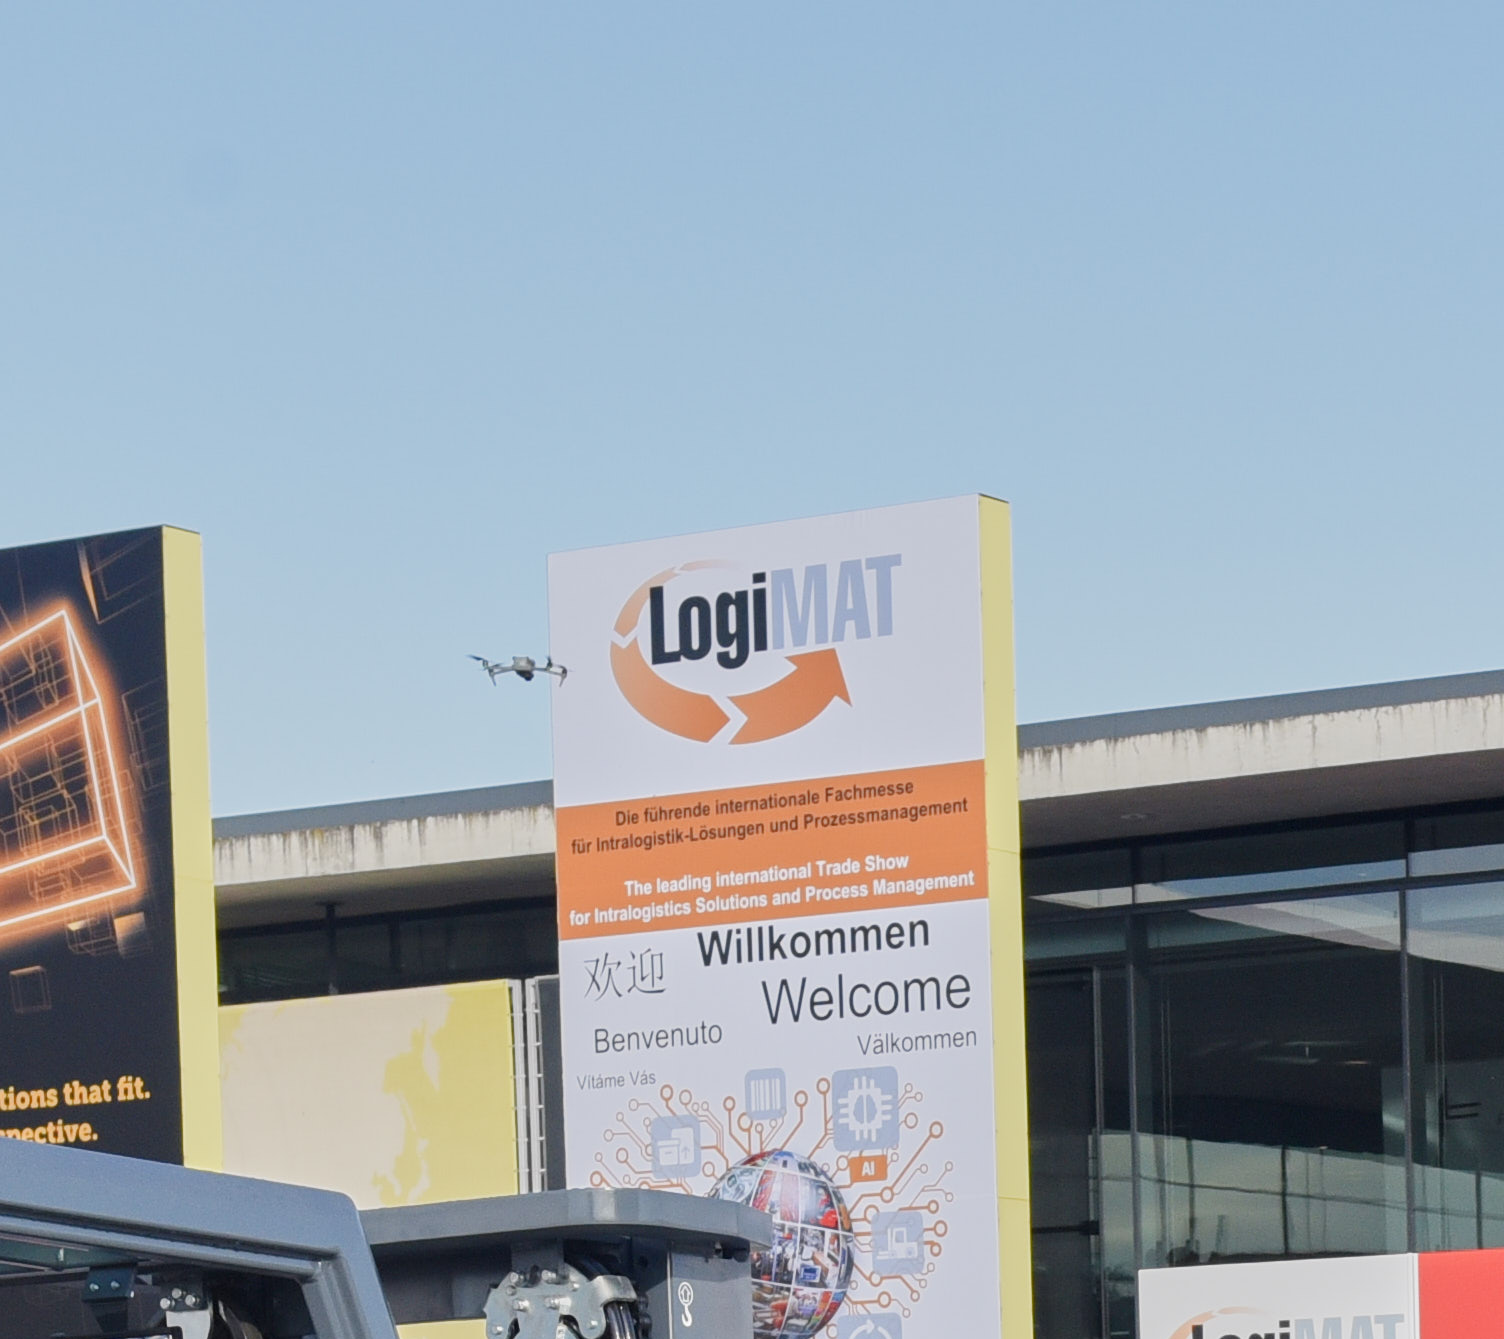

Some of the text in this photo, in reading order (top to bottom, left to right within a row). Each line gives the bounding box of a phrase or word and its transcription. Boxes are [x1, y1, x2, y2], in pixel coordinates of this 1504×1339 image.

[649, 553, 902, 669] LogiMAT
[571, 797, 969, 856] für Intralogistik-Lösungen und Prozessmanagement
[615, 779, 914, 827] Die führende internationale Fachmesse
[569, 869, 975, 926] for Intralogistics Solutions and Process Management
[624, 852, 909, 898] The leading international Trade Show
[697, 918, 930, 967] Willkommen
[583, 947, 667, 1002] 欢迎
[761, 972, 972, 1025] Welcome
[594, 1019, 724, 1055] Benvenuto
[857, 1028, 978, 1056] Välkommen
[63, 1079, 112, 1106] that
[117, 1075, 151, 1101] fit.
[577, 1069, 656, 1091] Vítáme Vás
[861, 1160, 876, 1177] AI
